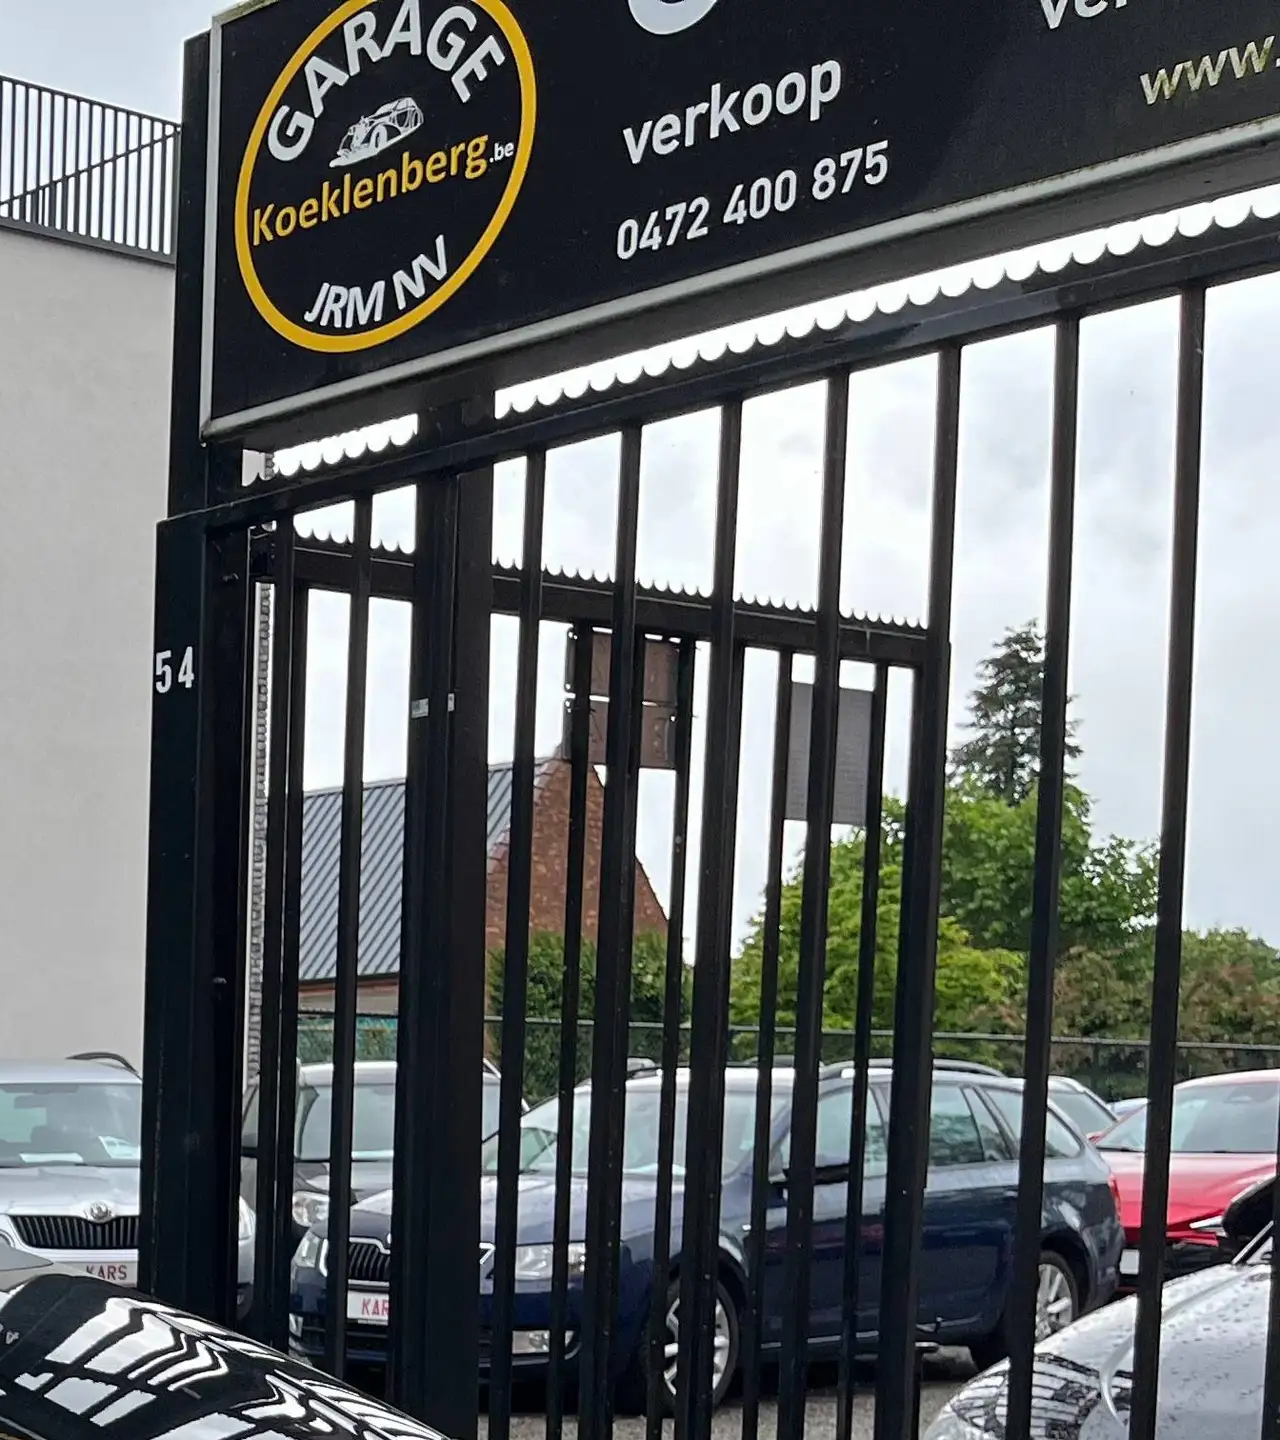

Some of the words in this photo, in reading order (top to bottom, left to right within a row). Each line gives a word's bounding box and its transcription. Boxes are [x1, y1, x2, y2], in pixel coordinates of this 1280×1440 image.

[267, 0, 506, 161] GARAGE
[622, 58, 842, 165] verkoop
[252, 134, 515, 246] Koeklenberg.be
[615, 196, 710, 261] 0472
[721, 169, 798, 226] 400
[811, 140, 890, 201] 875
[303, 280, 386, 328] JRM
[392, 234, 449, 310] NV
[155, 646, 195, 693] 54
[85, 1264, 128, 1281] KARS
